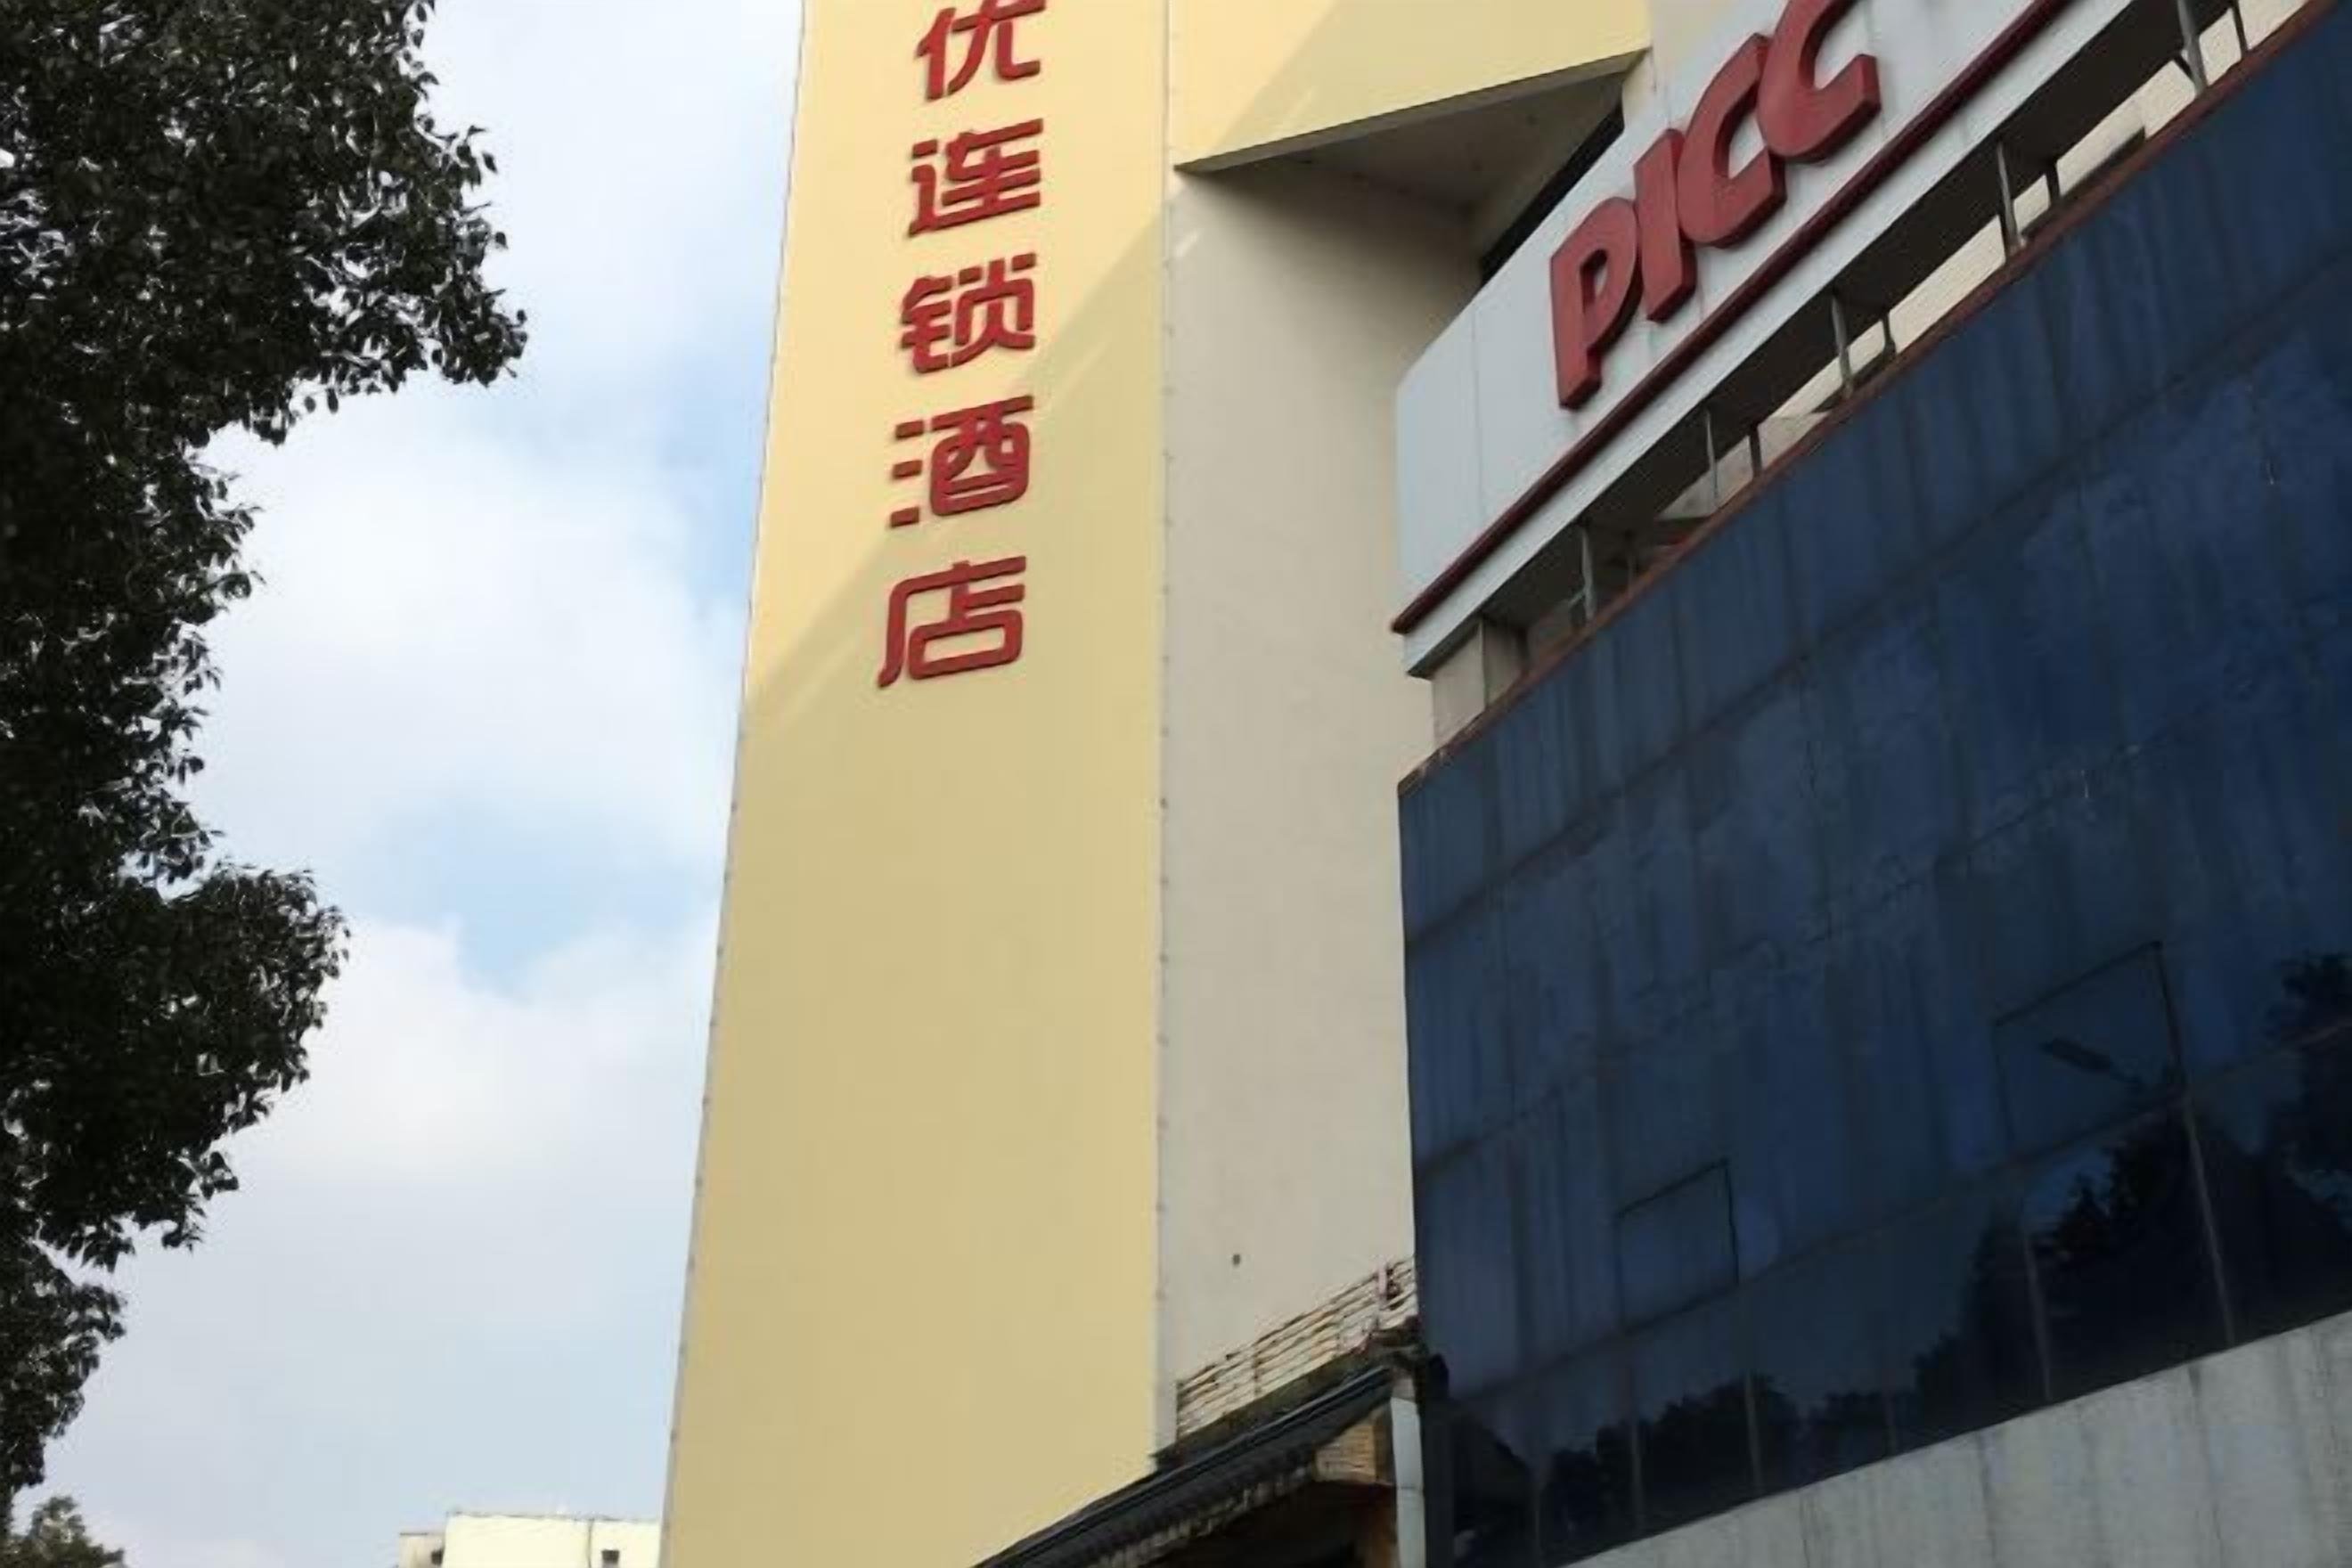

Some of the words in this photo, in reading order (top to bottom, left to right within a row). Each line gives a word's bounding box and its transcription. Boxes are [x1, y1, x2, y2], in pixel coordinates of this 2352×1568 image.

[877, 0, 1049, 688] 优连锁酒店
[1549, 0, 1882, 411] PICC
